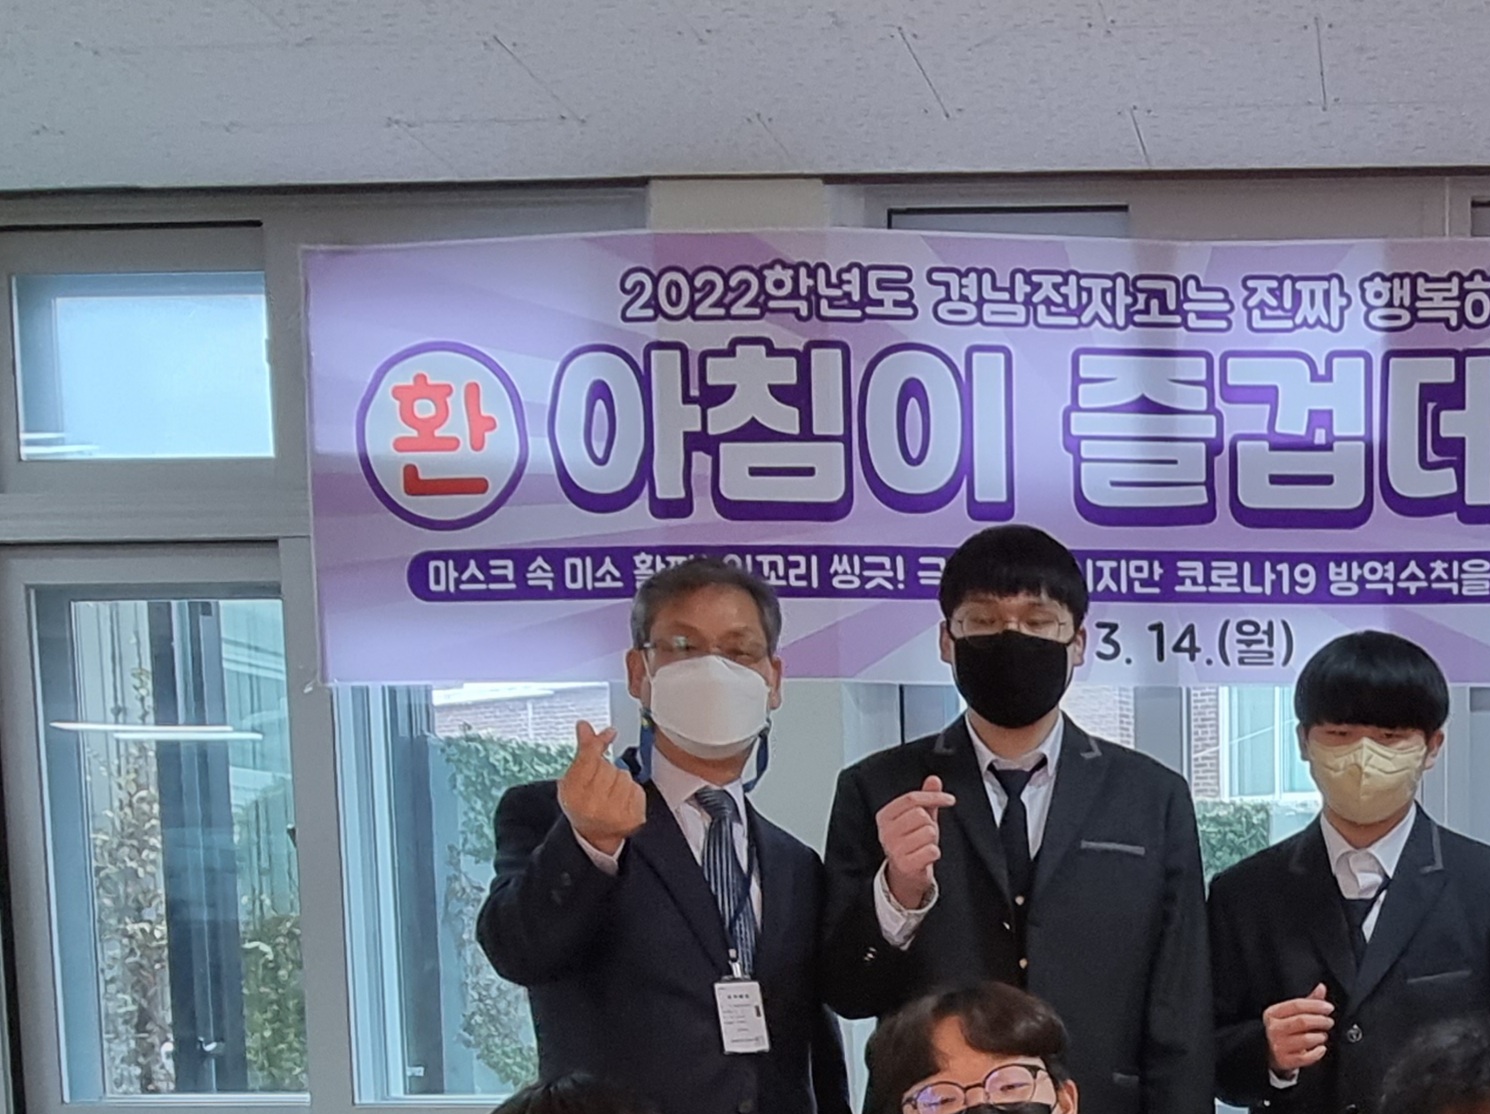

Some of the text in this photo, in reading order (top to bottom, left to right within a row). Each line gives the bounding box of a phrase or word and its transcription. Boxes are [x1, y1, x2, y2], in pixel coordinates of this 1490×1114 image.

[619, 259, 918, 323] 2022학년도
[927, 267, 1233, 330] 경남전자고는
[1242, 272, 1350, 332] 진짜
[391, 371, 497, 497] 환
[549, 338, 1014, 520] 아침이
[427, 558, 517, 593] 마스크
[525, 556, 555, 591] 속
[564, 555, 625, 591] 미소
[829, 554, 905, 591] 씽긋!
[1086, 558, 1163, 594] 지만
[1174, 559, 1317, 596] 코로나19
[1094, 618, 1295, 668] 3. 14.(월)
